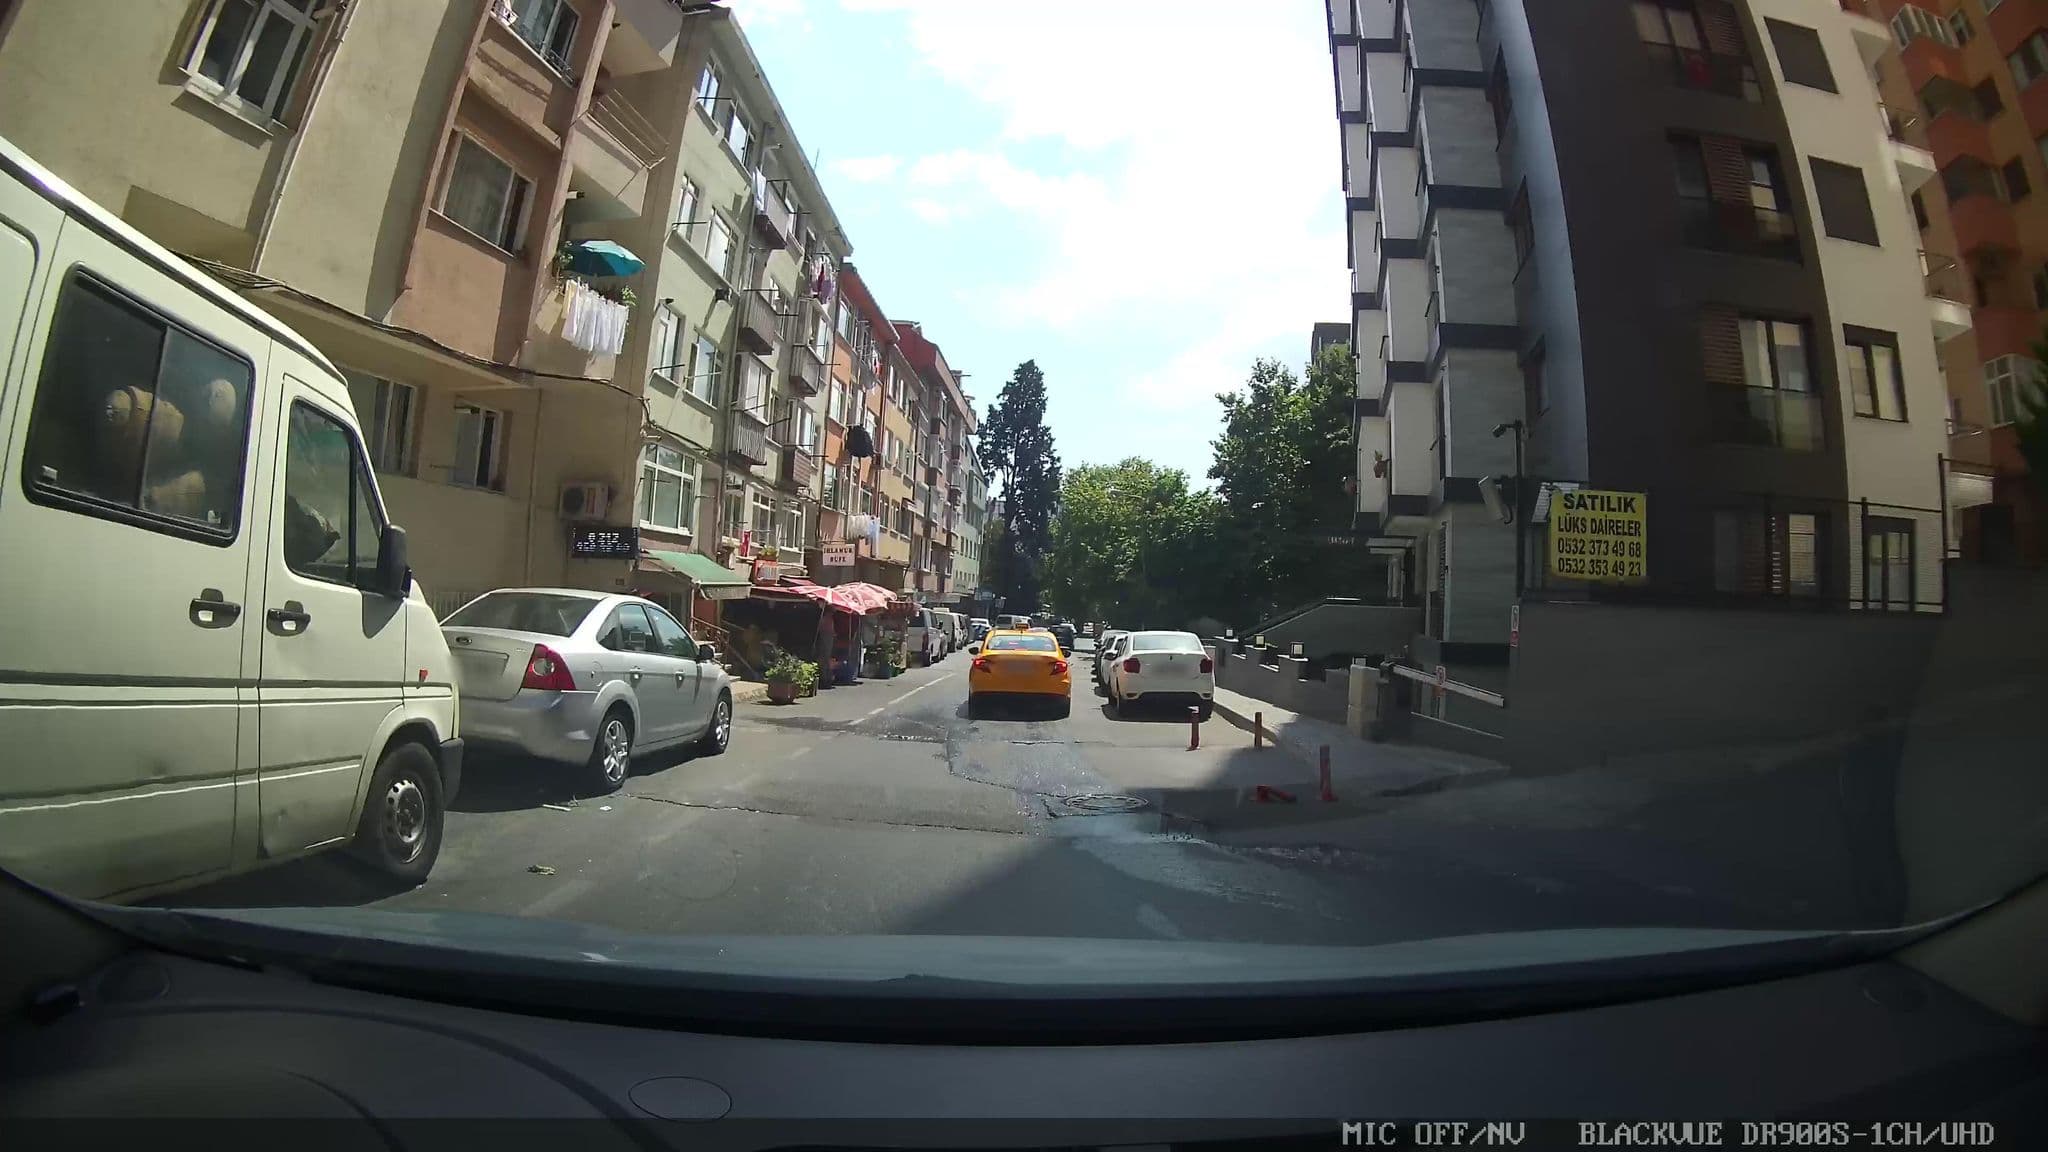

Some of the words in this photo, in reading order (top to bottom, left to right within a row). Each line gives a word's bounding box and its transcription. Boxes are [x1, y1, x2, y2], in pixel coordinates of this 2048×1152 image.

[1563, 493, 1636, 513] SATILIK
[1558, 513, 1587, 534] LÜKS
[1590, 515, 1642, 537] DAİRELER
[1557, 538, 1586, 555] 0532
[1588, 540, 1609, 556] 373
[1612, 541, 1625, 557] 49
[1628, 542, 1641, 558] 68
[1557, 558, 1586, 574] 0532
[1588, 559, 1609, 576] 353
[1612, 561, 1625, 577] 49
[1628, 562, 1641, 577] 23
